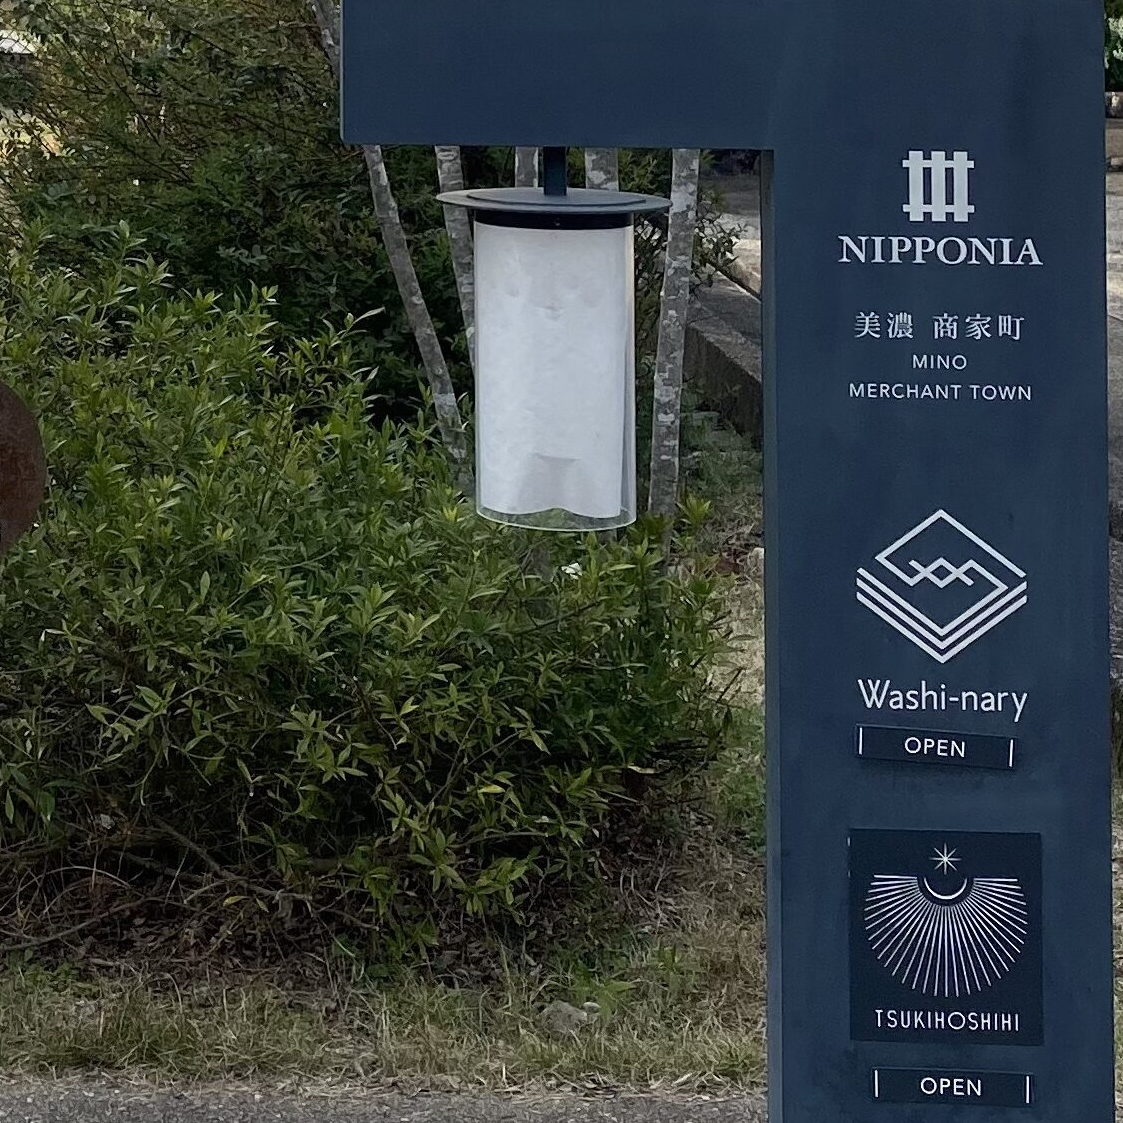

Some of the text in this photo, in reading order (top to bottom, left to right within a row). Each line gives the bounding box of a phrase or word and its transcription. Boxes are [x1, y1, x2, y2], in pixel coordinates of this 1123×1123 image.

[838, 235, 1043, 266] NIPPONIA
[854, 311, 1026, 341] 美濃 商家町
[912, 354, 968, 370] MINO
[848, 383, 1032, 401] MERCHANT TOWN
[857, 678, 1028, 723] Washi-nary
[904, 736, 966, 758] OPEN
[874, 1009, 1020, 1032] TSUKIHOSHIHI
[920, 1077, 982, 1097] OPEN
